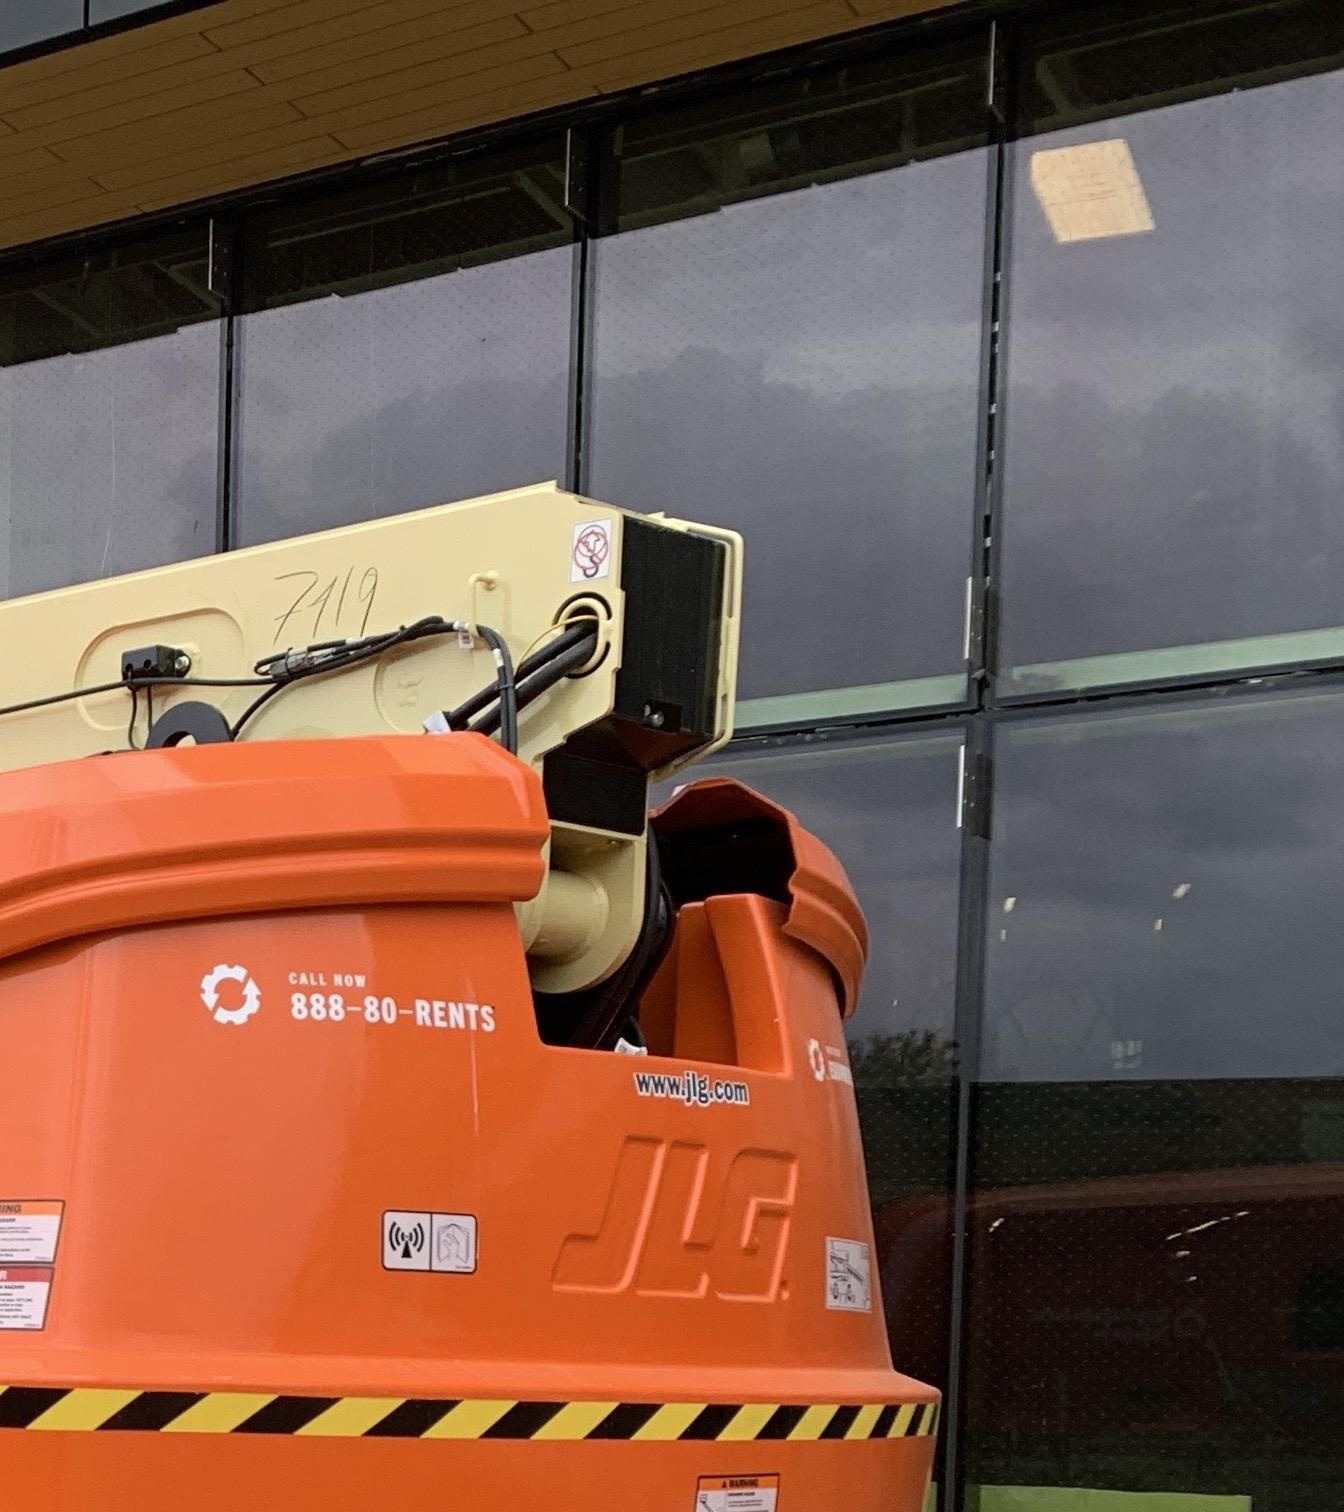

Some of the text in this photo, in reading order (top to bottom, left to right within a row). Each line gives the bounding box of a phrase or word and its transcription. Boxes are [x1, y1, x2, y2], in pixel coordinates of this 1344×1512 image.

[288, 972, 367, 989] CALL NOW
[290, 992, 496, 1033] 888-80-RENTS
[633, 1070, 752, 1106] www.jlg.com
[551, 1133, 801, 1304] JLG
